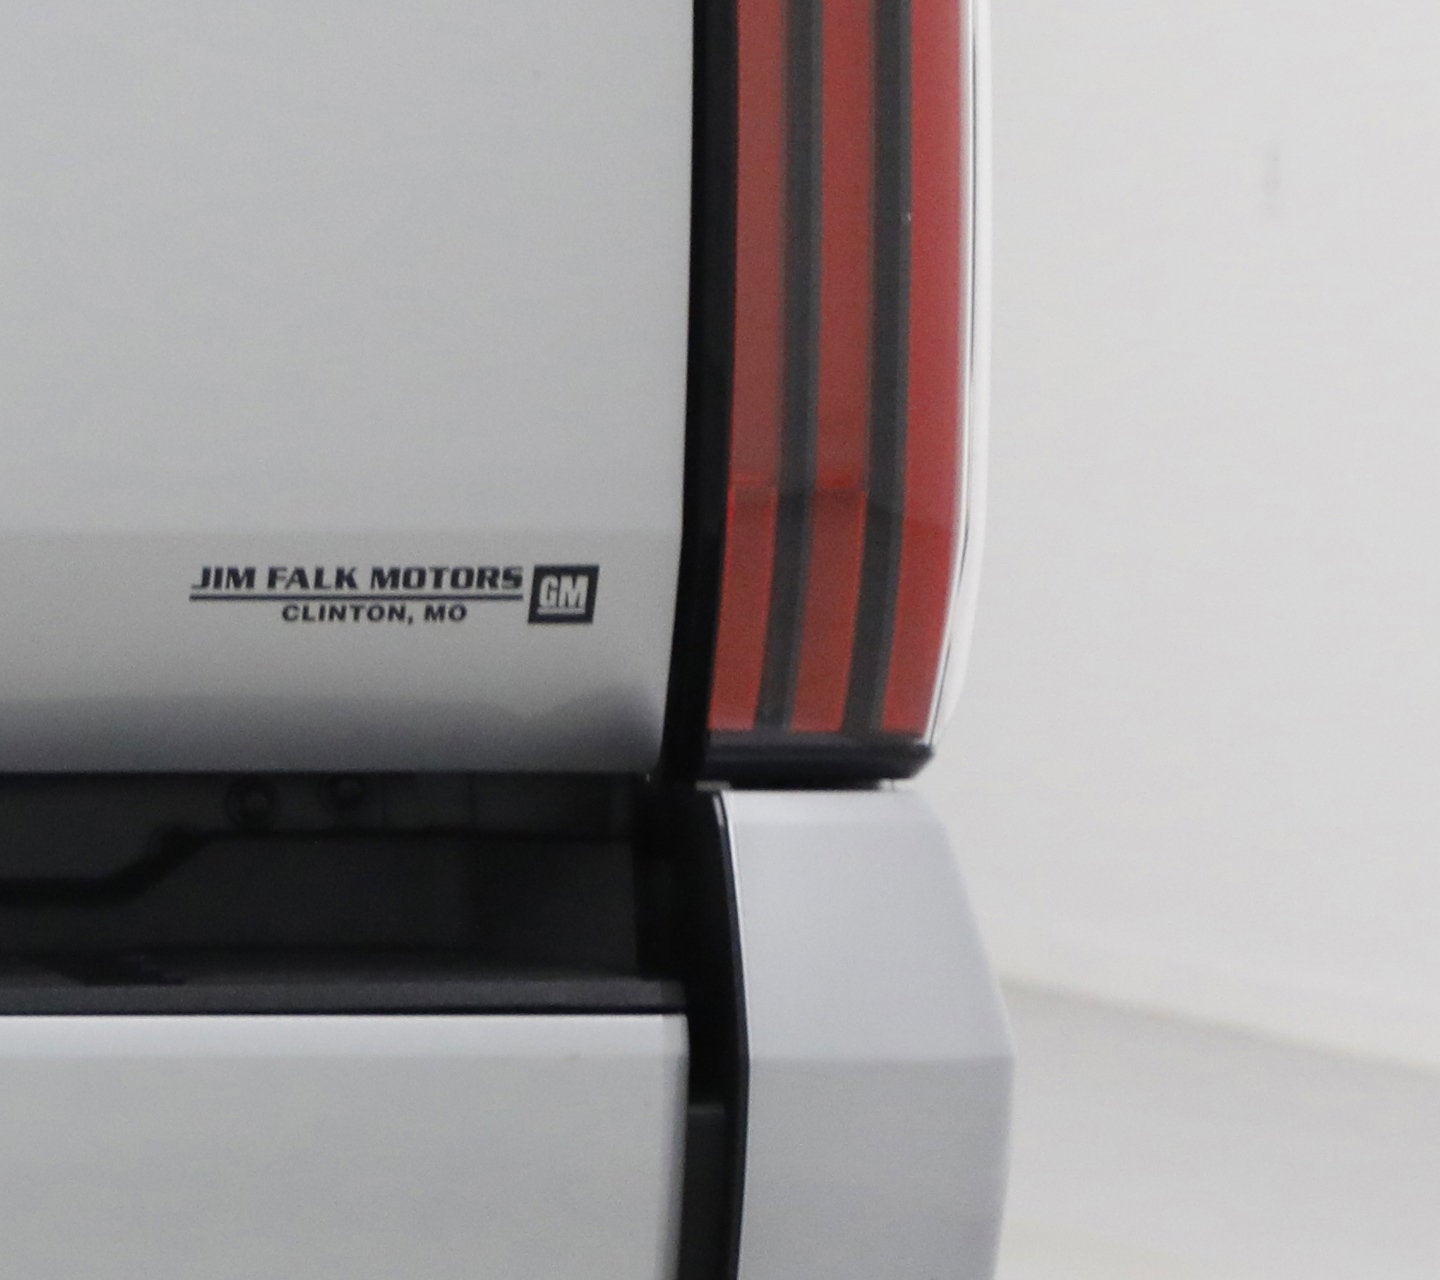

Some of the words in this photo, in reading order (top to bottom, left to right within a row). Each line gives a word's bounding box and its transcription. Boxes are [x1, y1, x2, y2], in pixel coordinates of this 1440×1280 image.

[191, 566, 258, 590] JIM
[266, 566, 359, 590] FALK
[369, 566, 524, 591] MOTORS
[539, 575, 589, 608] GM
[281, 602, 415, 626] CLINTON,
[423, 602, 468, 623] MO
